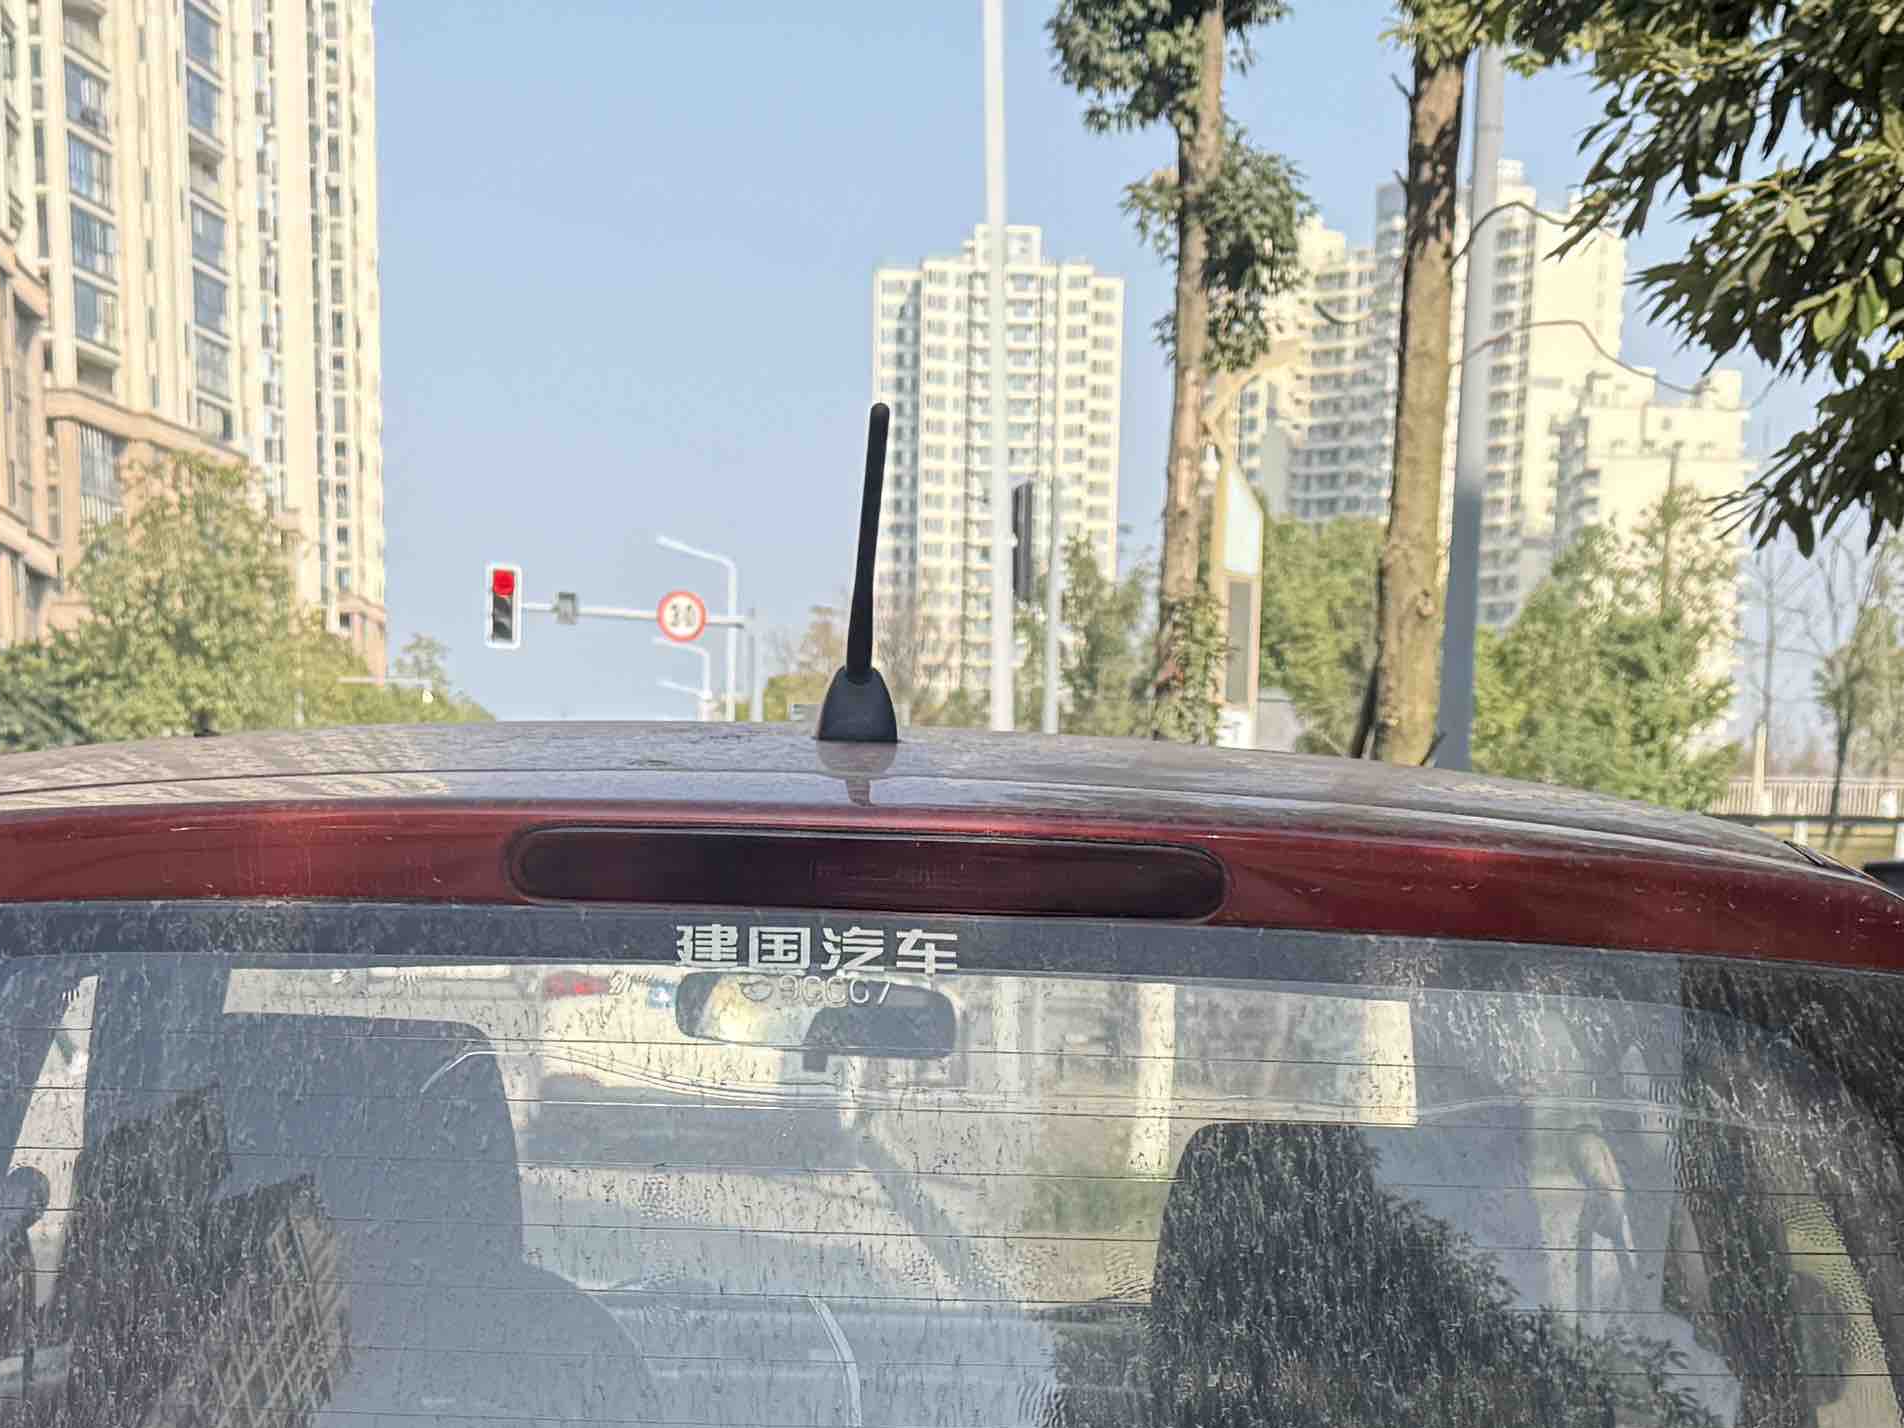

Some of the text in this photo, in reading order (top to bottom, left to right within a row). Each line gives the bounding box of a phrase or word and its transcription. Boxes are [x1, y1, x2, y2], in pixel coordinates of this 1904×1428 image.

[670, 602, 696, 628] 30
[675, 923, 958, 975] 建国汽车
